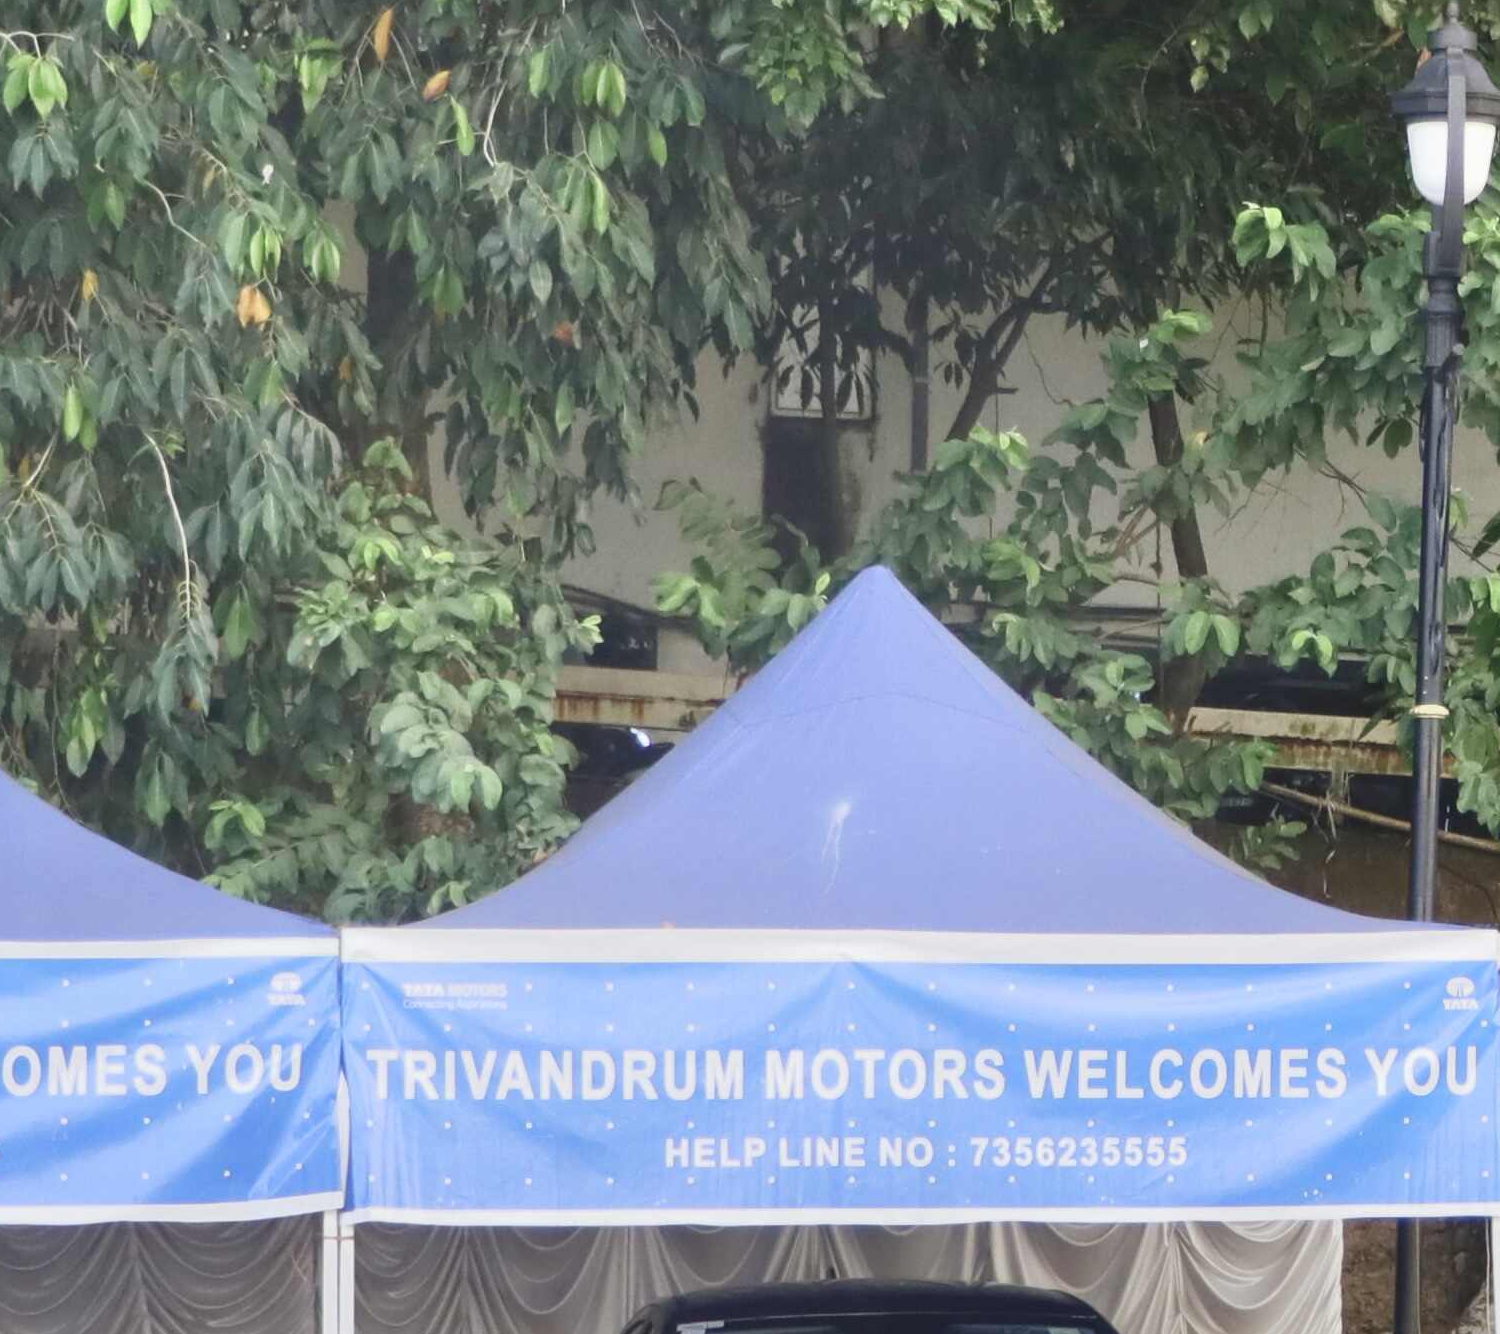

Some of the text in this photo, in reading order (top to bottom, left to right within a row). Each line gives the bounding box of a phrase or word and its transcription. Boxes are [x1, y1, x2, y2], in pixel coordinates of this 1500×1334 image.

[185, 1042, 304, 1095] YOU
[367, 1046, 1478, 1101] TRIVANDRUM MOTORS WELCOMES YOU
[665, 1137, 767, 1168] HELP
[779, 1137, 866, 1167] LINE
[879, 1137, 934, 1167] NO
[969, 1136, 1188, 1167] 7356235555
